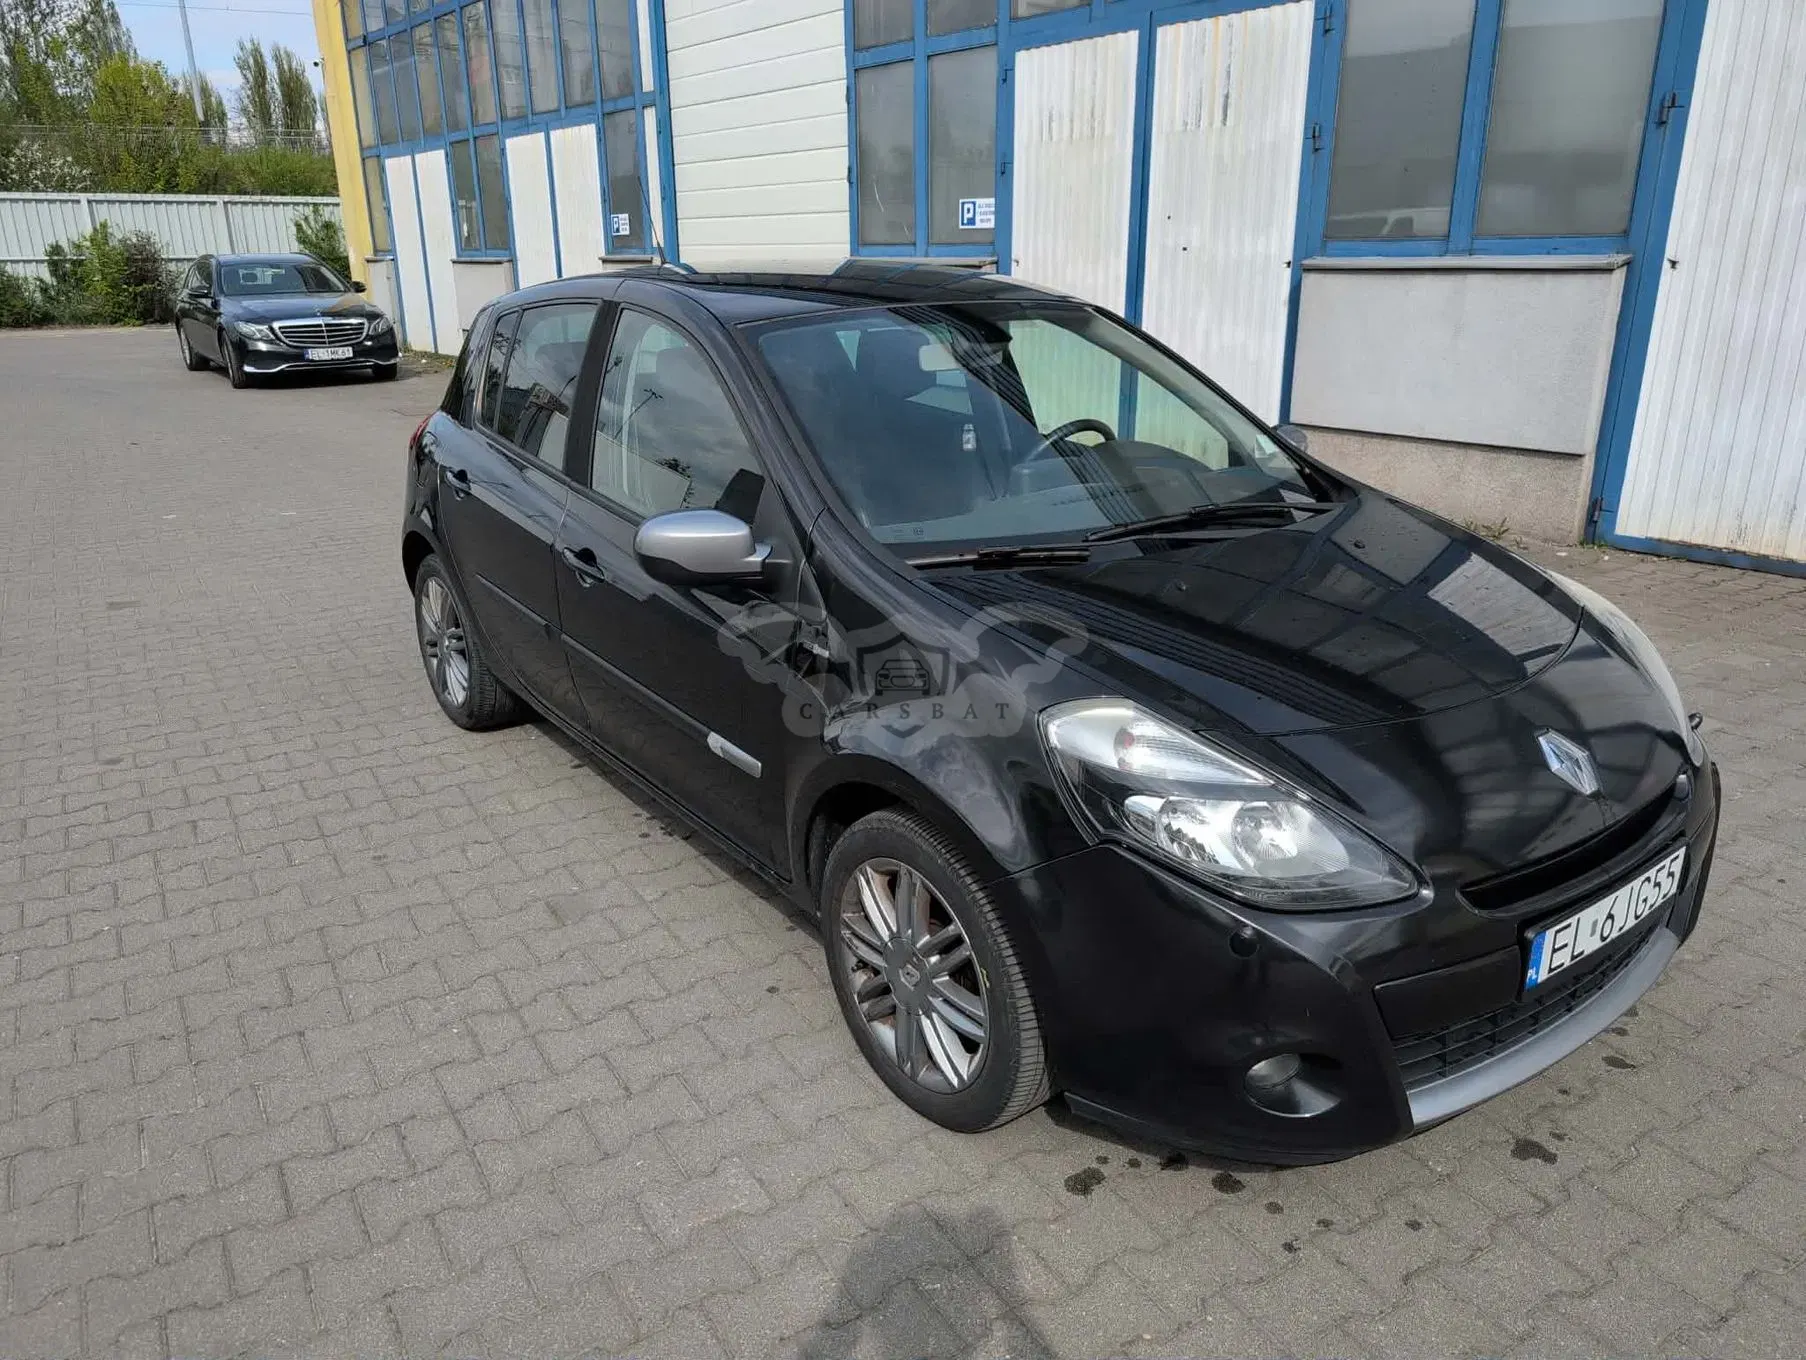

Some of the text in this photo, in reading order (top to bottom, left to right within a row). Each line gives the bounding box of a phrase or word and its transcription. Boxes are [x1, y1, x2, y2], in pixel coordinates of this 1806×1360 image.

[963, 203, 974, 224] P
[613, 217, 619, 232] P
[1547, 853, 1680, 974] EL 6JG55
